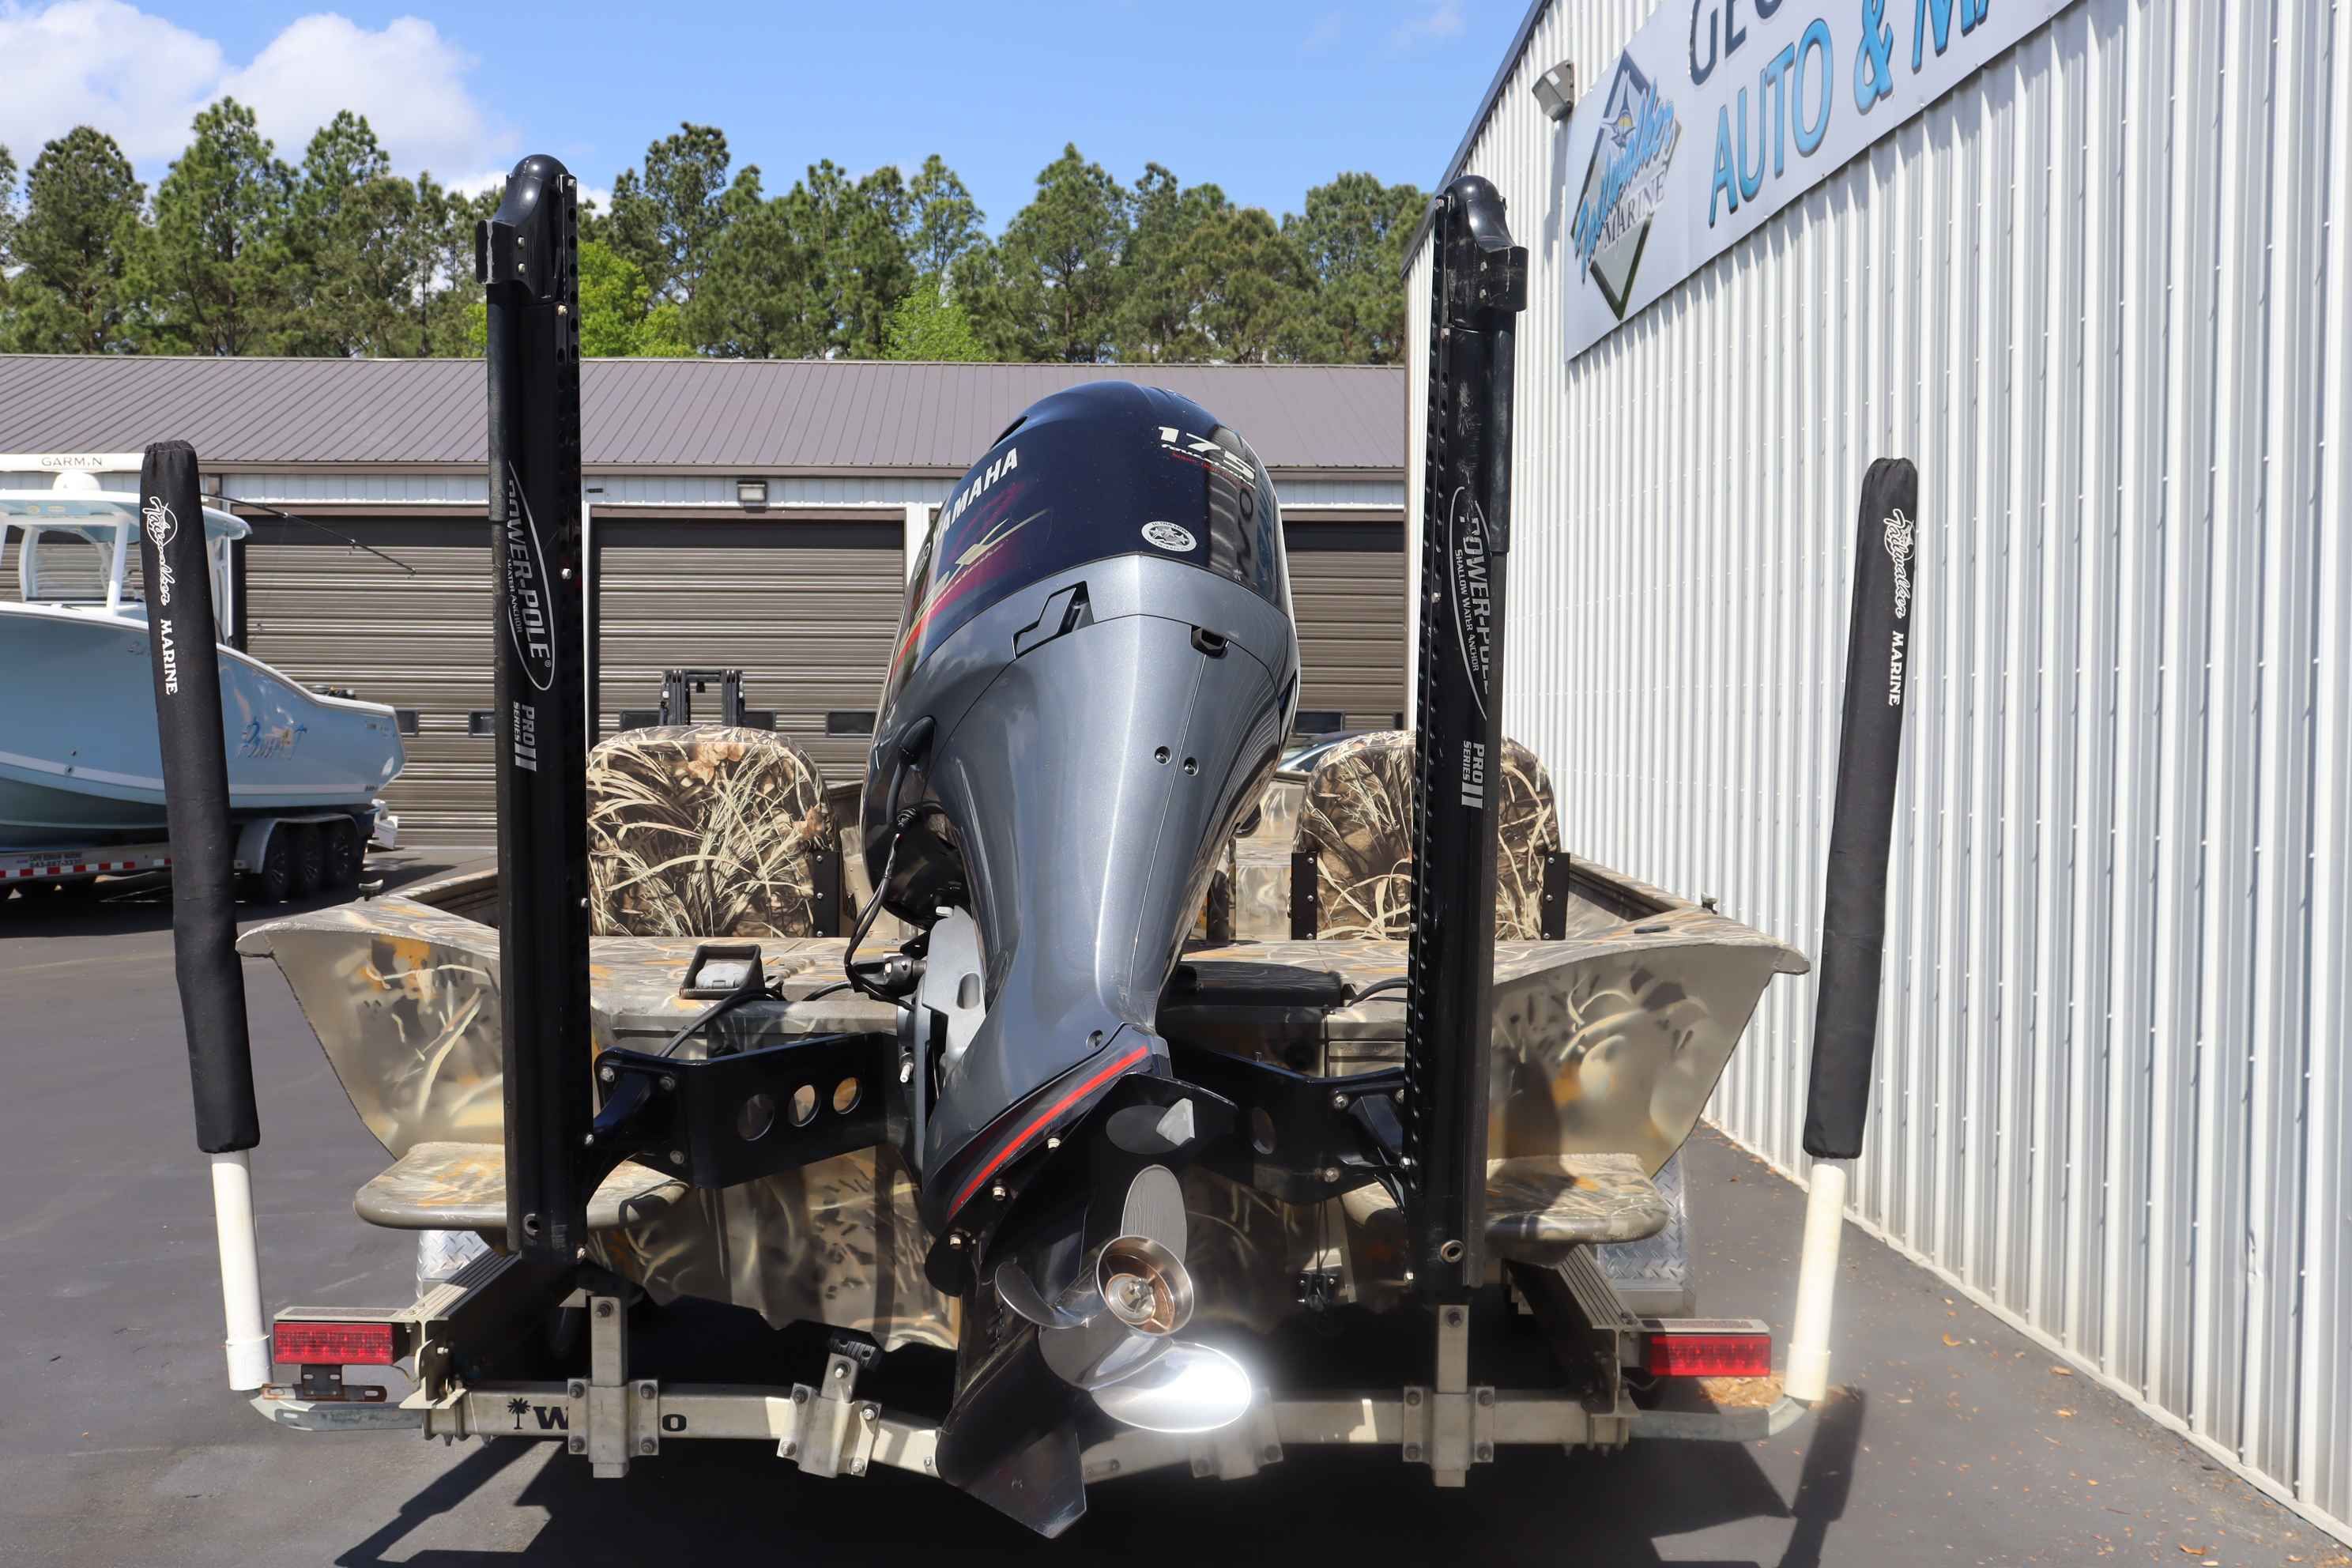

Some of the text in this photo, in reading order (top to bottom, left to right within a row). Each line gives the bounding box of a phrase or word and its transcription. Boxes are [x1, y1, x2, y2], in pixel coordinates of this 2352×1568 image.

[1709, 18, 1834, 229] AUTO
[1853, 0, 1894, 116] &
[1159, 426, 1256, 481] 175
[932, 447, 1019, 551] YAMAHA
[1454, 548, 1479, 672] SHALLOW WATER ANCHOR
[160, 618, 178, 696] MARINE
[1888, 630, 1905, 707] MARINE
[522, 704, 535, 746] PRO
[1462, 740, 1472, 782] SERIES
[1472, 743, 1486, 784] PRO
